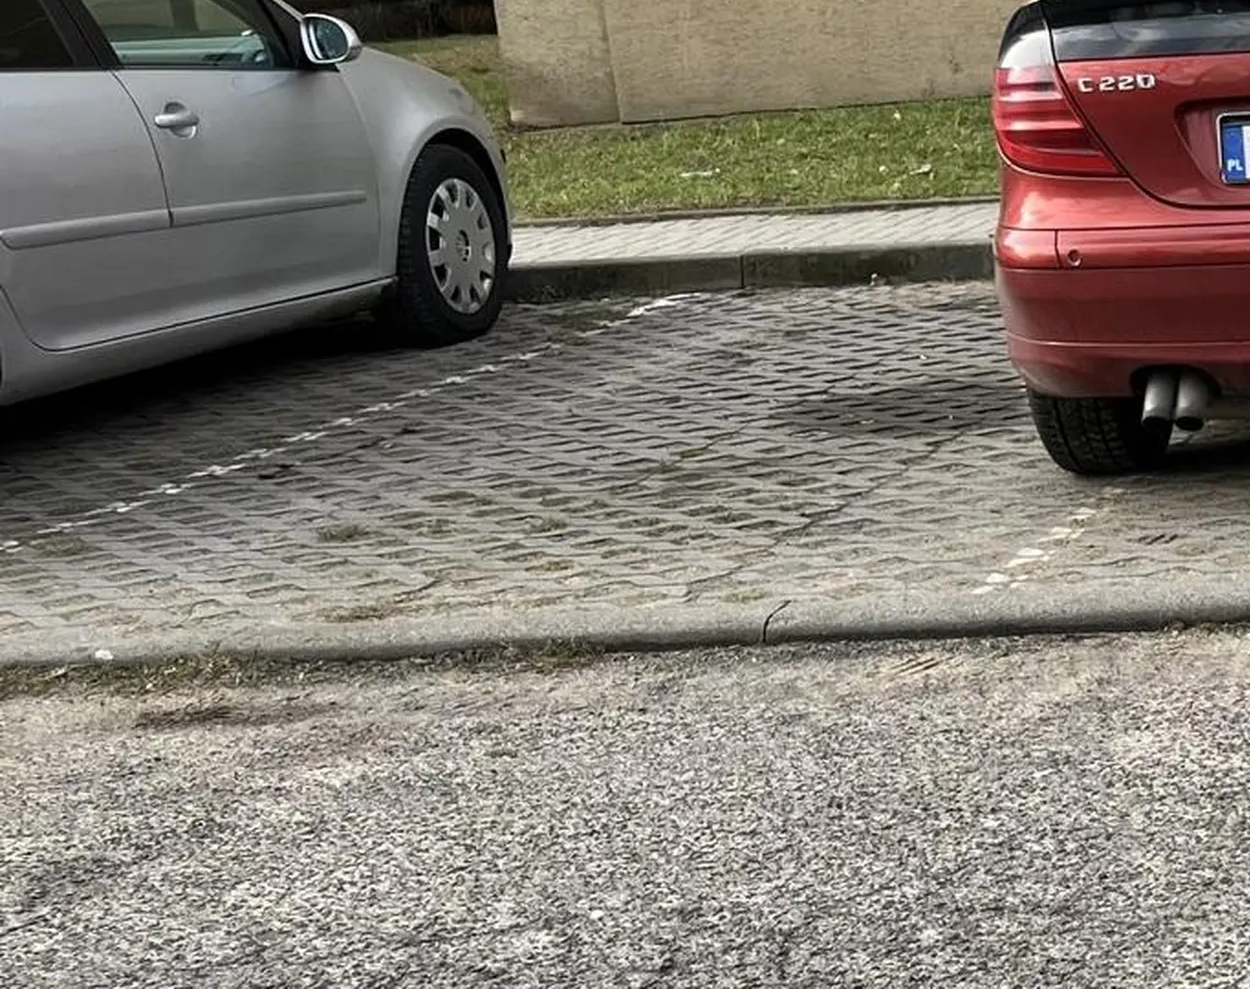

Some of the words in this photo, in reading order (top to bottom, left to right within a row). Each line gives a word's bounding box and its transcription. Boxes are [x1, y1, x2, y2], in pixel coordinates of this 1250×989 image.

[1078, 77, 1094, 93] C
[1099, 74, 1156, 92] 220
[1227, 159, 1244, 172] PL
